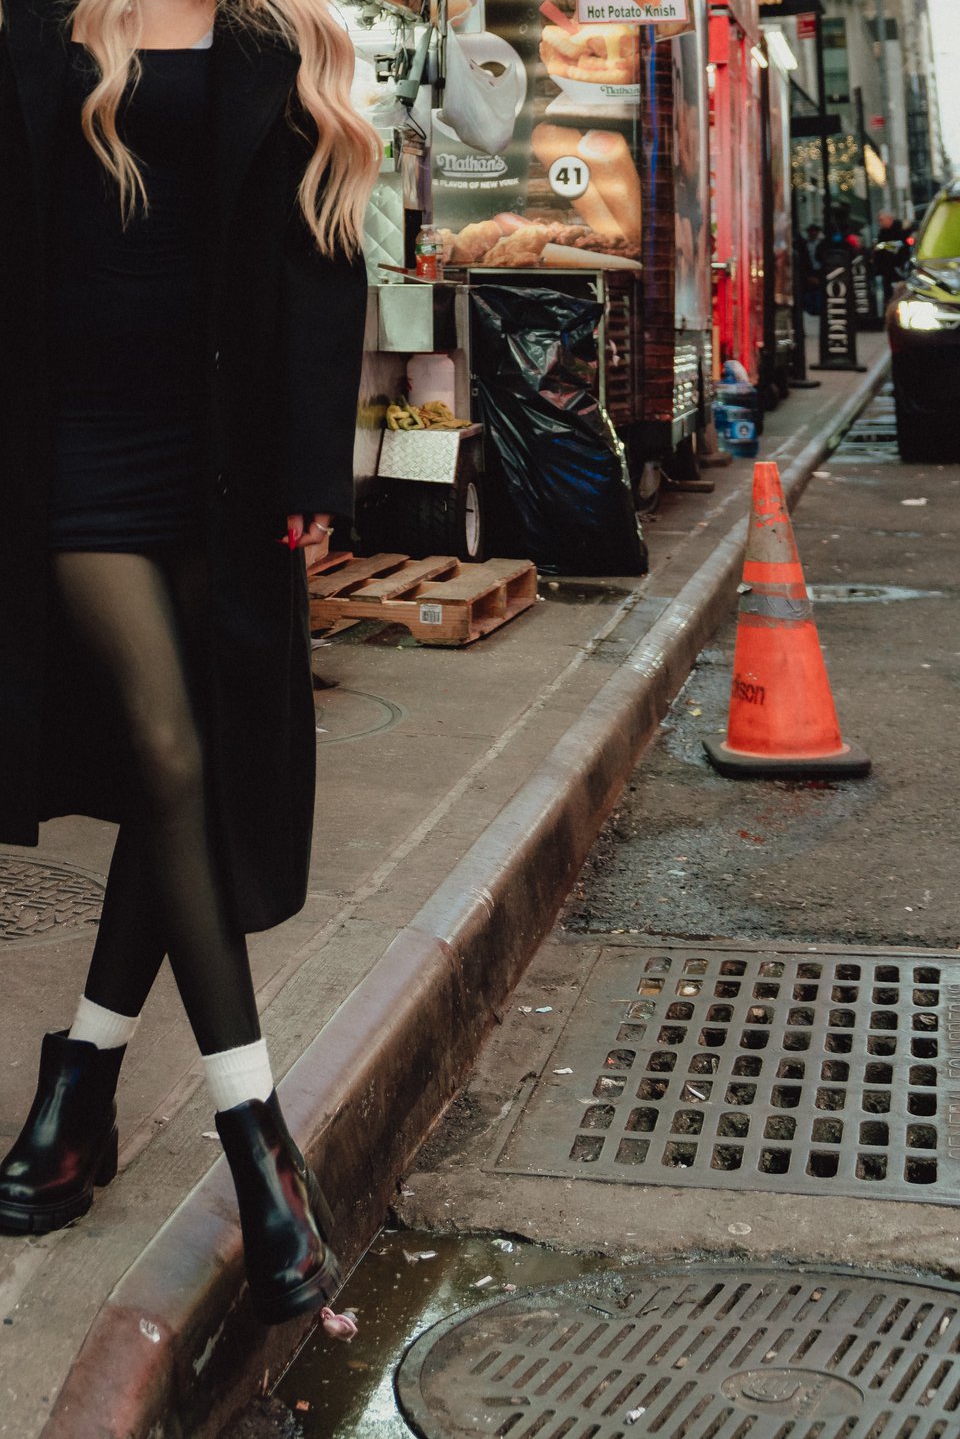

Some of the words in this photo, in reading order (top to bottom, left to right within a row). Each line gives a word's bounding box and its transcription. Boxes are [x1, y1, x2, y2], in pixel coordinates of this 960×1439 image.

[587, 5, 607, 20] Hot
[607, 5, 642, 20] Potato
[644, 4, 677, 19] Knish
[436, 153, 508, 175] Nathan's
[469, 181, 479, 190] OF
[480, 180, 498, 189] NEW
[555, 166, 582, 186] 41
[825, 266, 848, 354] EDITION
